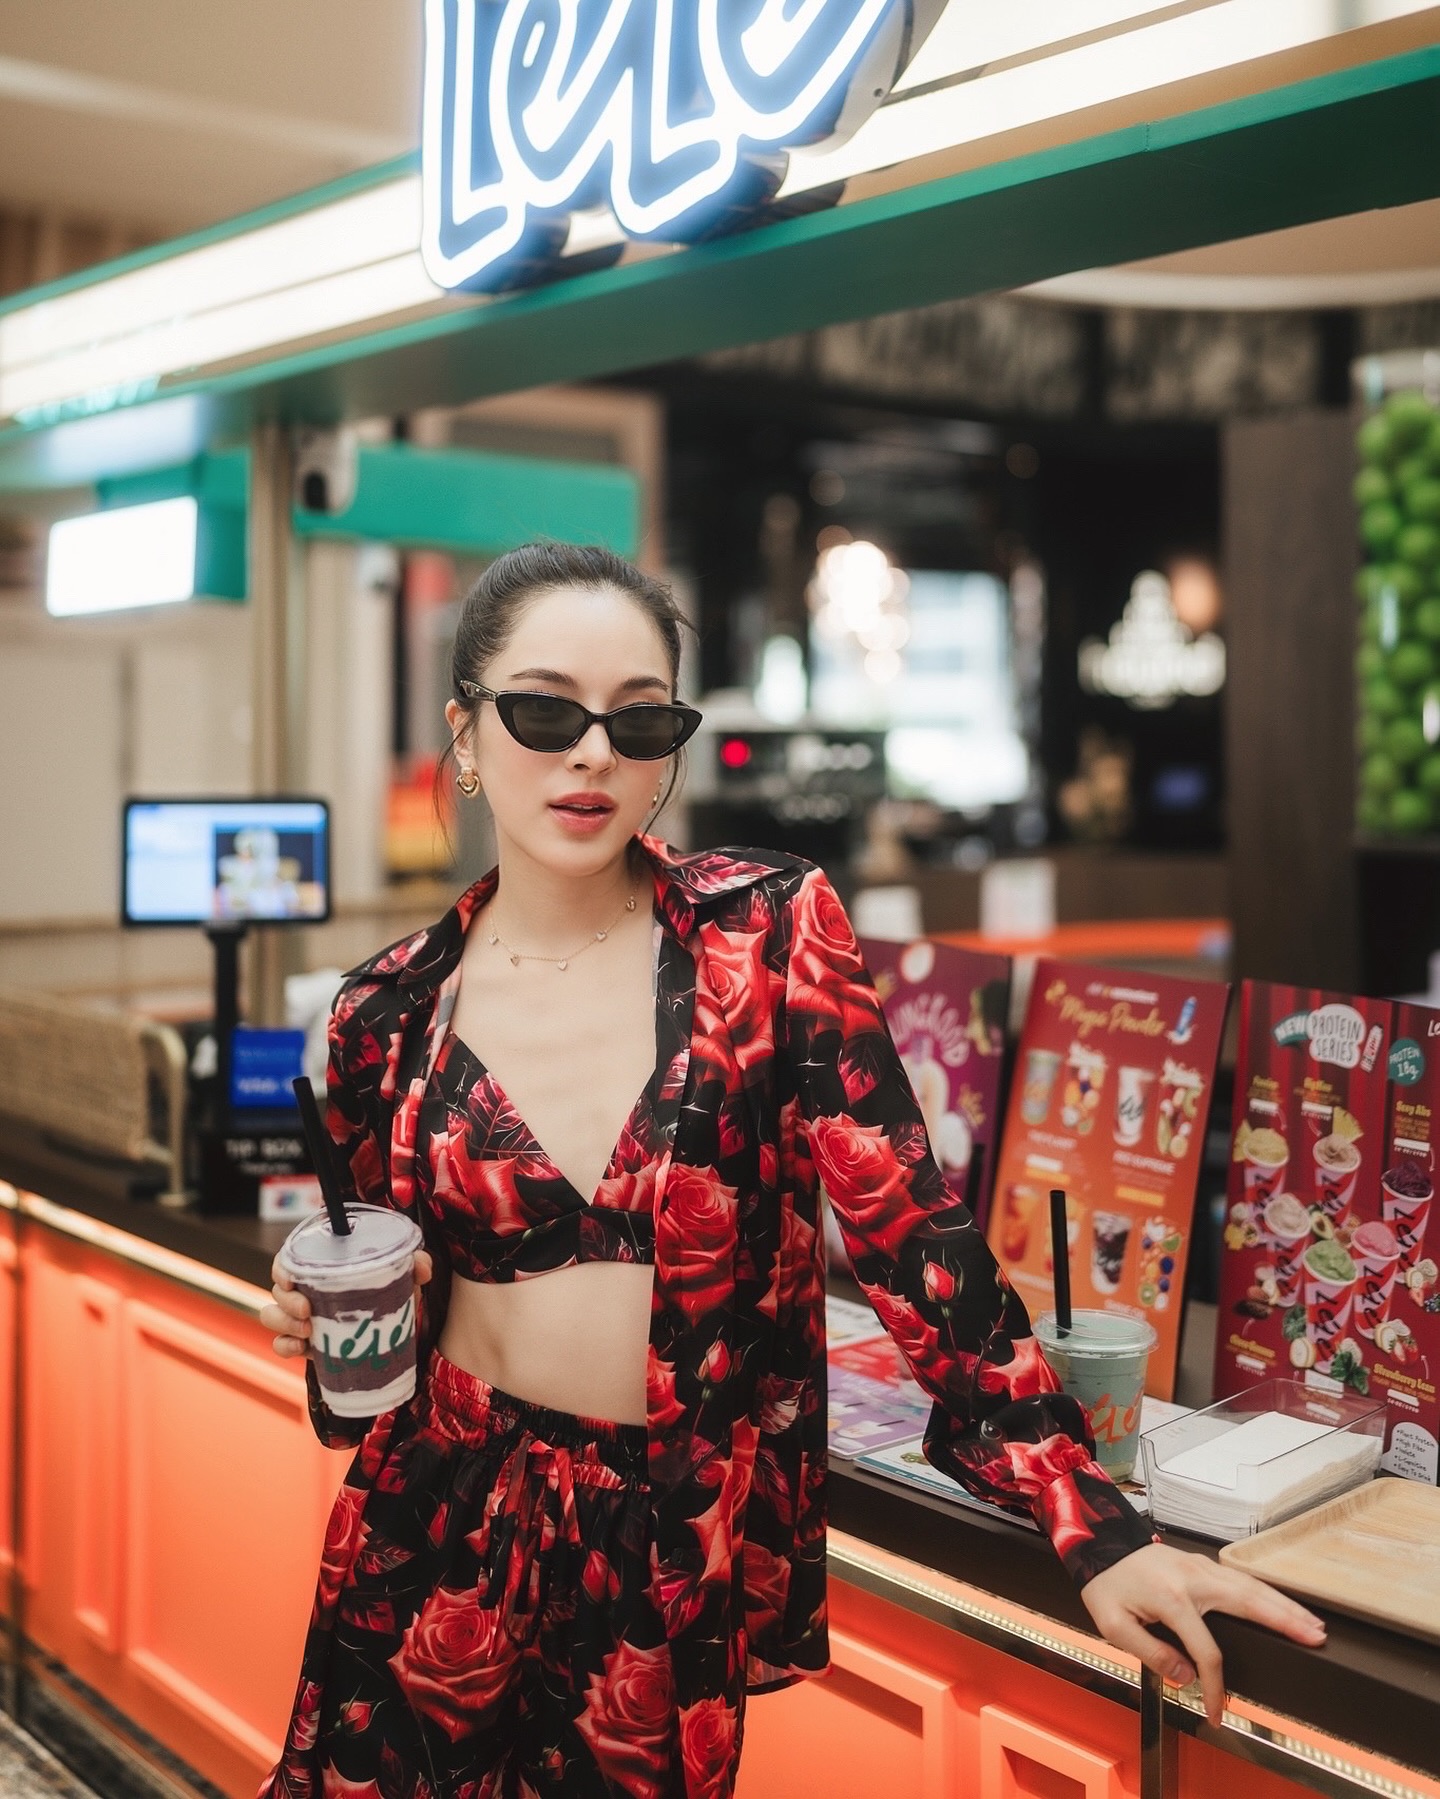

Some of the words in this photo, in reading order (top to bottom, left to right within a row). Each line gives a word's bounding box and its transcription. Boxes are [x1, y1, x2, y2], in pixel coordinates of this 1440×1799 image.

[1274, 1014, 1308, 1042] NEW
[1310, 1013, 1362, 1042] PROTEIN
[1315, 1037, 1355, 1063] SERIES
[1389, 1046, 1420, 1065] PROTEIN
[1373, 1362, 1418, 1389] Strawberry
